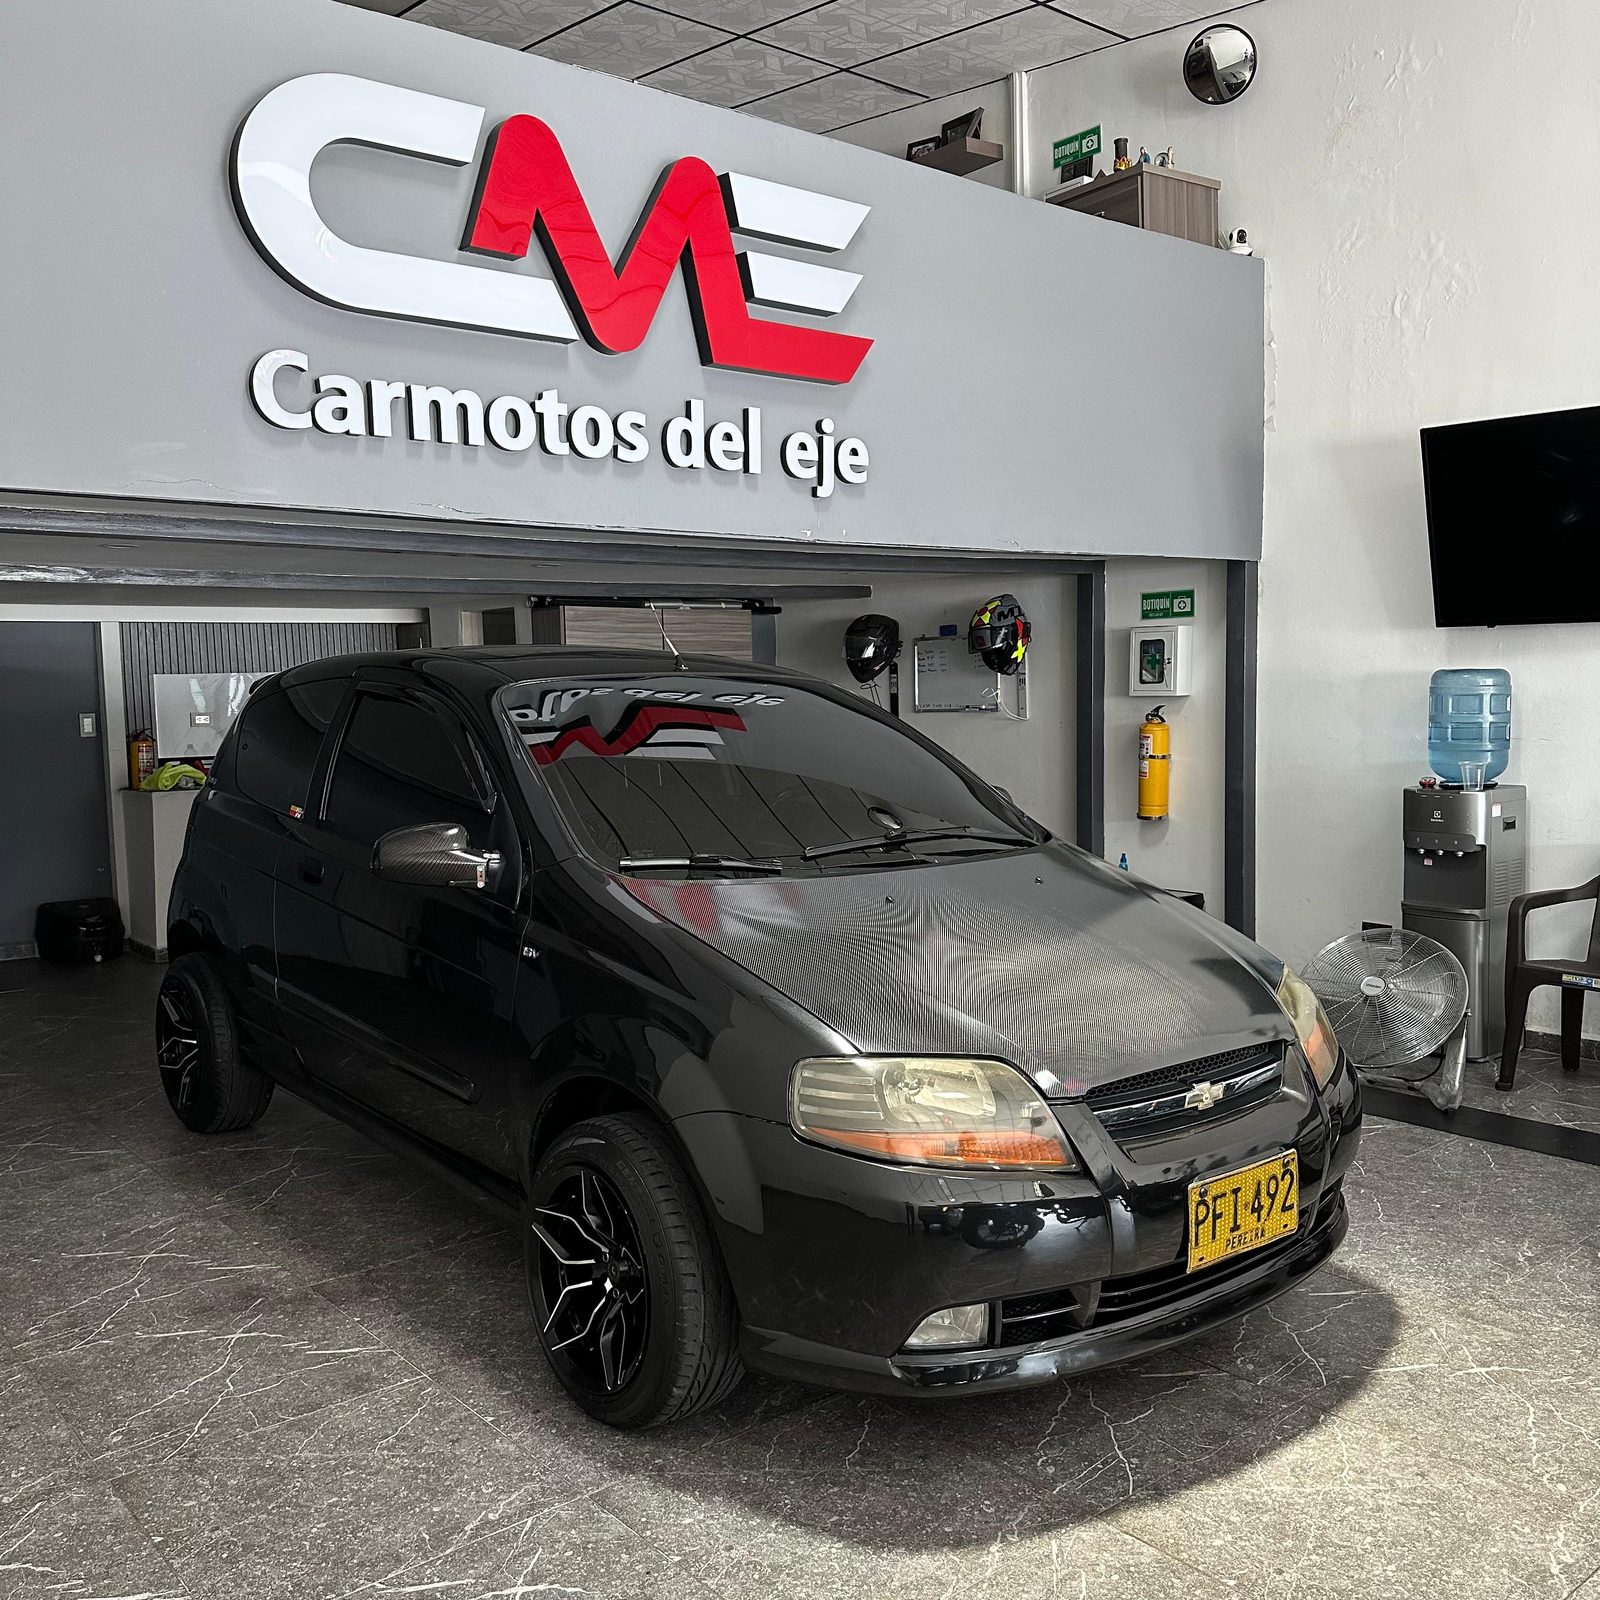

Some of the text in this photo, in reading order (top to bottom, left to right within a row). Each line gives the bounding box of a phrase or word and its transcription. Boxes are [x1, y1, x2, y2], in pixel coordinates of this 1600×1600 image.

[250, 348, 870, 497] Carmotos del eje
[1143, 595, 1170, 611] BOTIQUÍN
[1194, 1168, 1295, 1248] PFI 492
